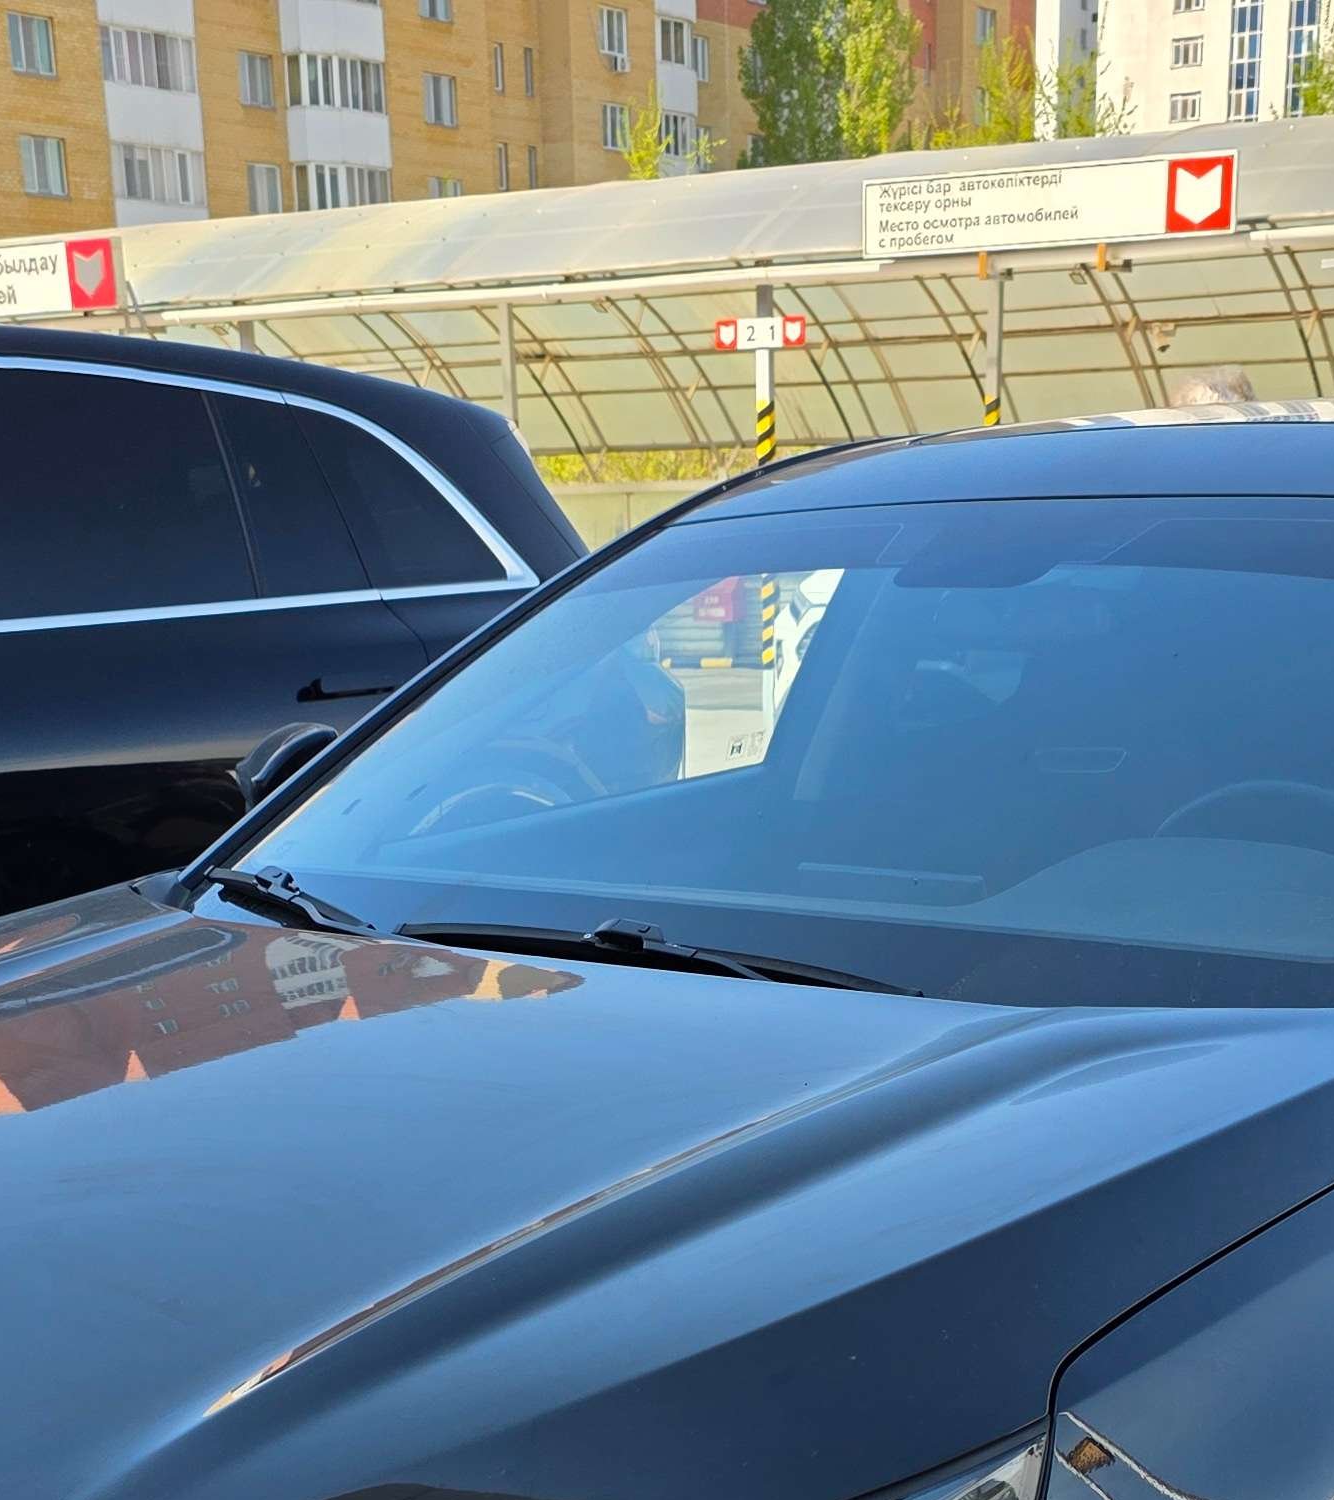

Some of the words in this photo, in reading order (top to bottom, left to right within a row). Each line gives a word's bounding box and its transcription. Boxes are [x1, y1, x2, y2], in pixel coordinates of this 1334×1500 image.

[926, 180, 951, 196] бар
[879, 199, 931, 213] тексеру
[934, 197, 972, 212] орны
[879, 219, 919, 233] Место
[923, 216, 980, 230] осмотра
[984, 206, 1079, 225] автомобилей
[879, 238, 886, 248] с
[889, 232, 955, 250] пробегом
[746, 325, 756, 342] 2
